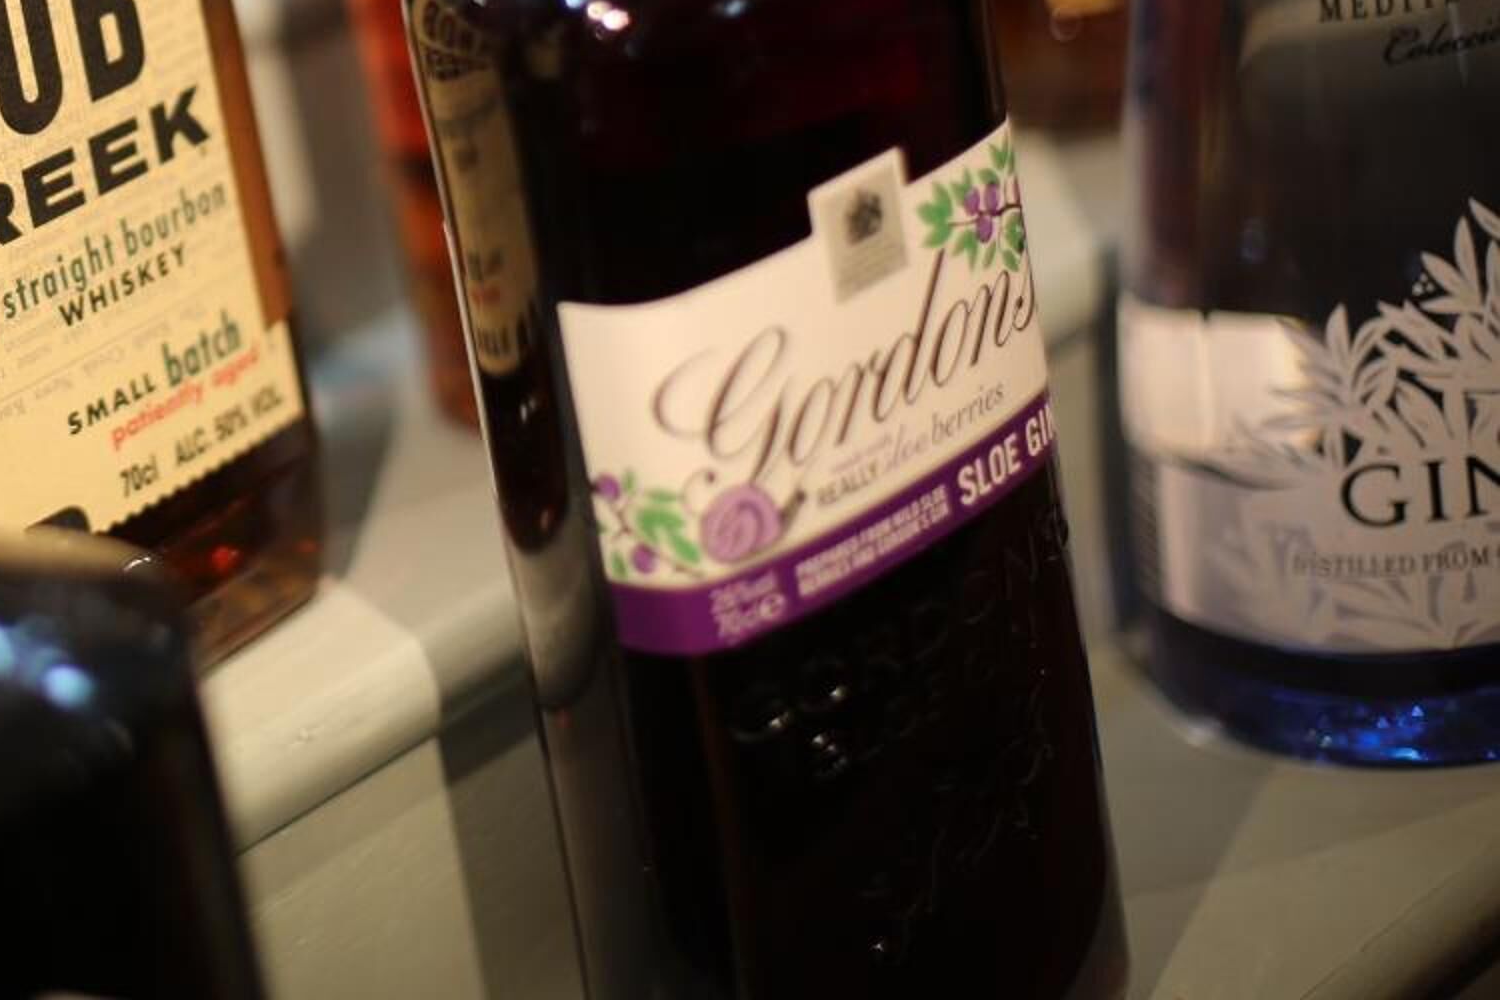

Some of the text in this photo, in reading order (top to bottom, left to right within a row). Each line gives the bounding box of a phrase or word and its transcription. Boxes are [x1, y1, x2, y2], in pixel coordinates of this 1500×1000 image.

[2, 236, 115, 319] straight
[119, 183, 225, 258] bourbon
[59, 245, 188, 327] WHISKEY
[67, 373, 156, 436] SMALL
[161, 307, 242, 388] batch
[930, 382, 1006, 446] berries
[119, 454, 160, 498] 70cl
[956, 432, 1022, 507] SLOE
[1422, 546, 1490, 573] FROM
